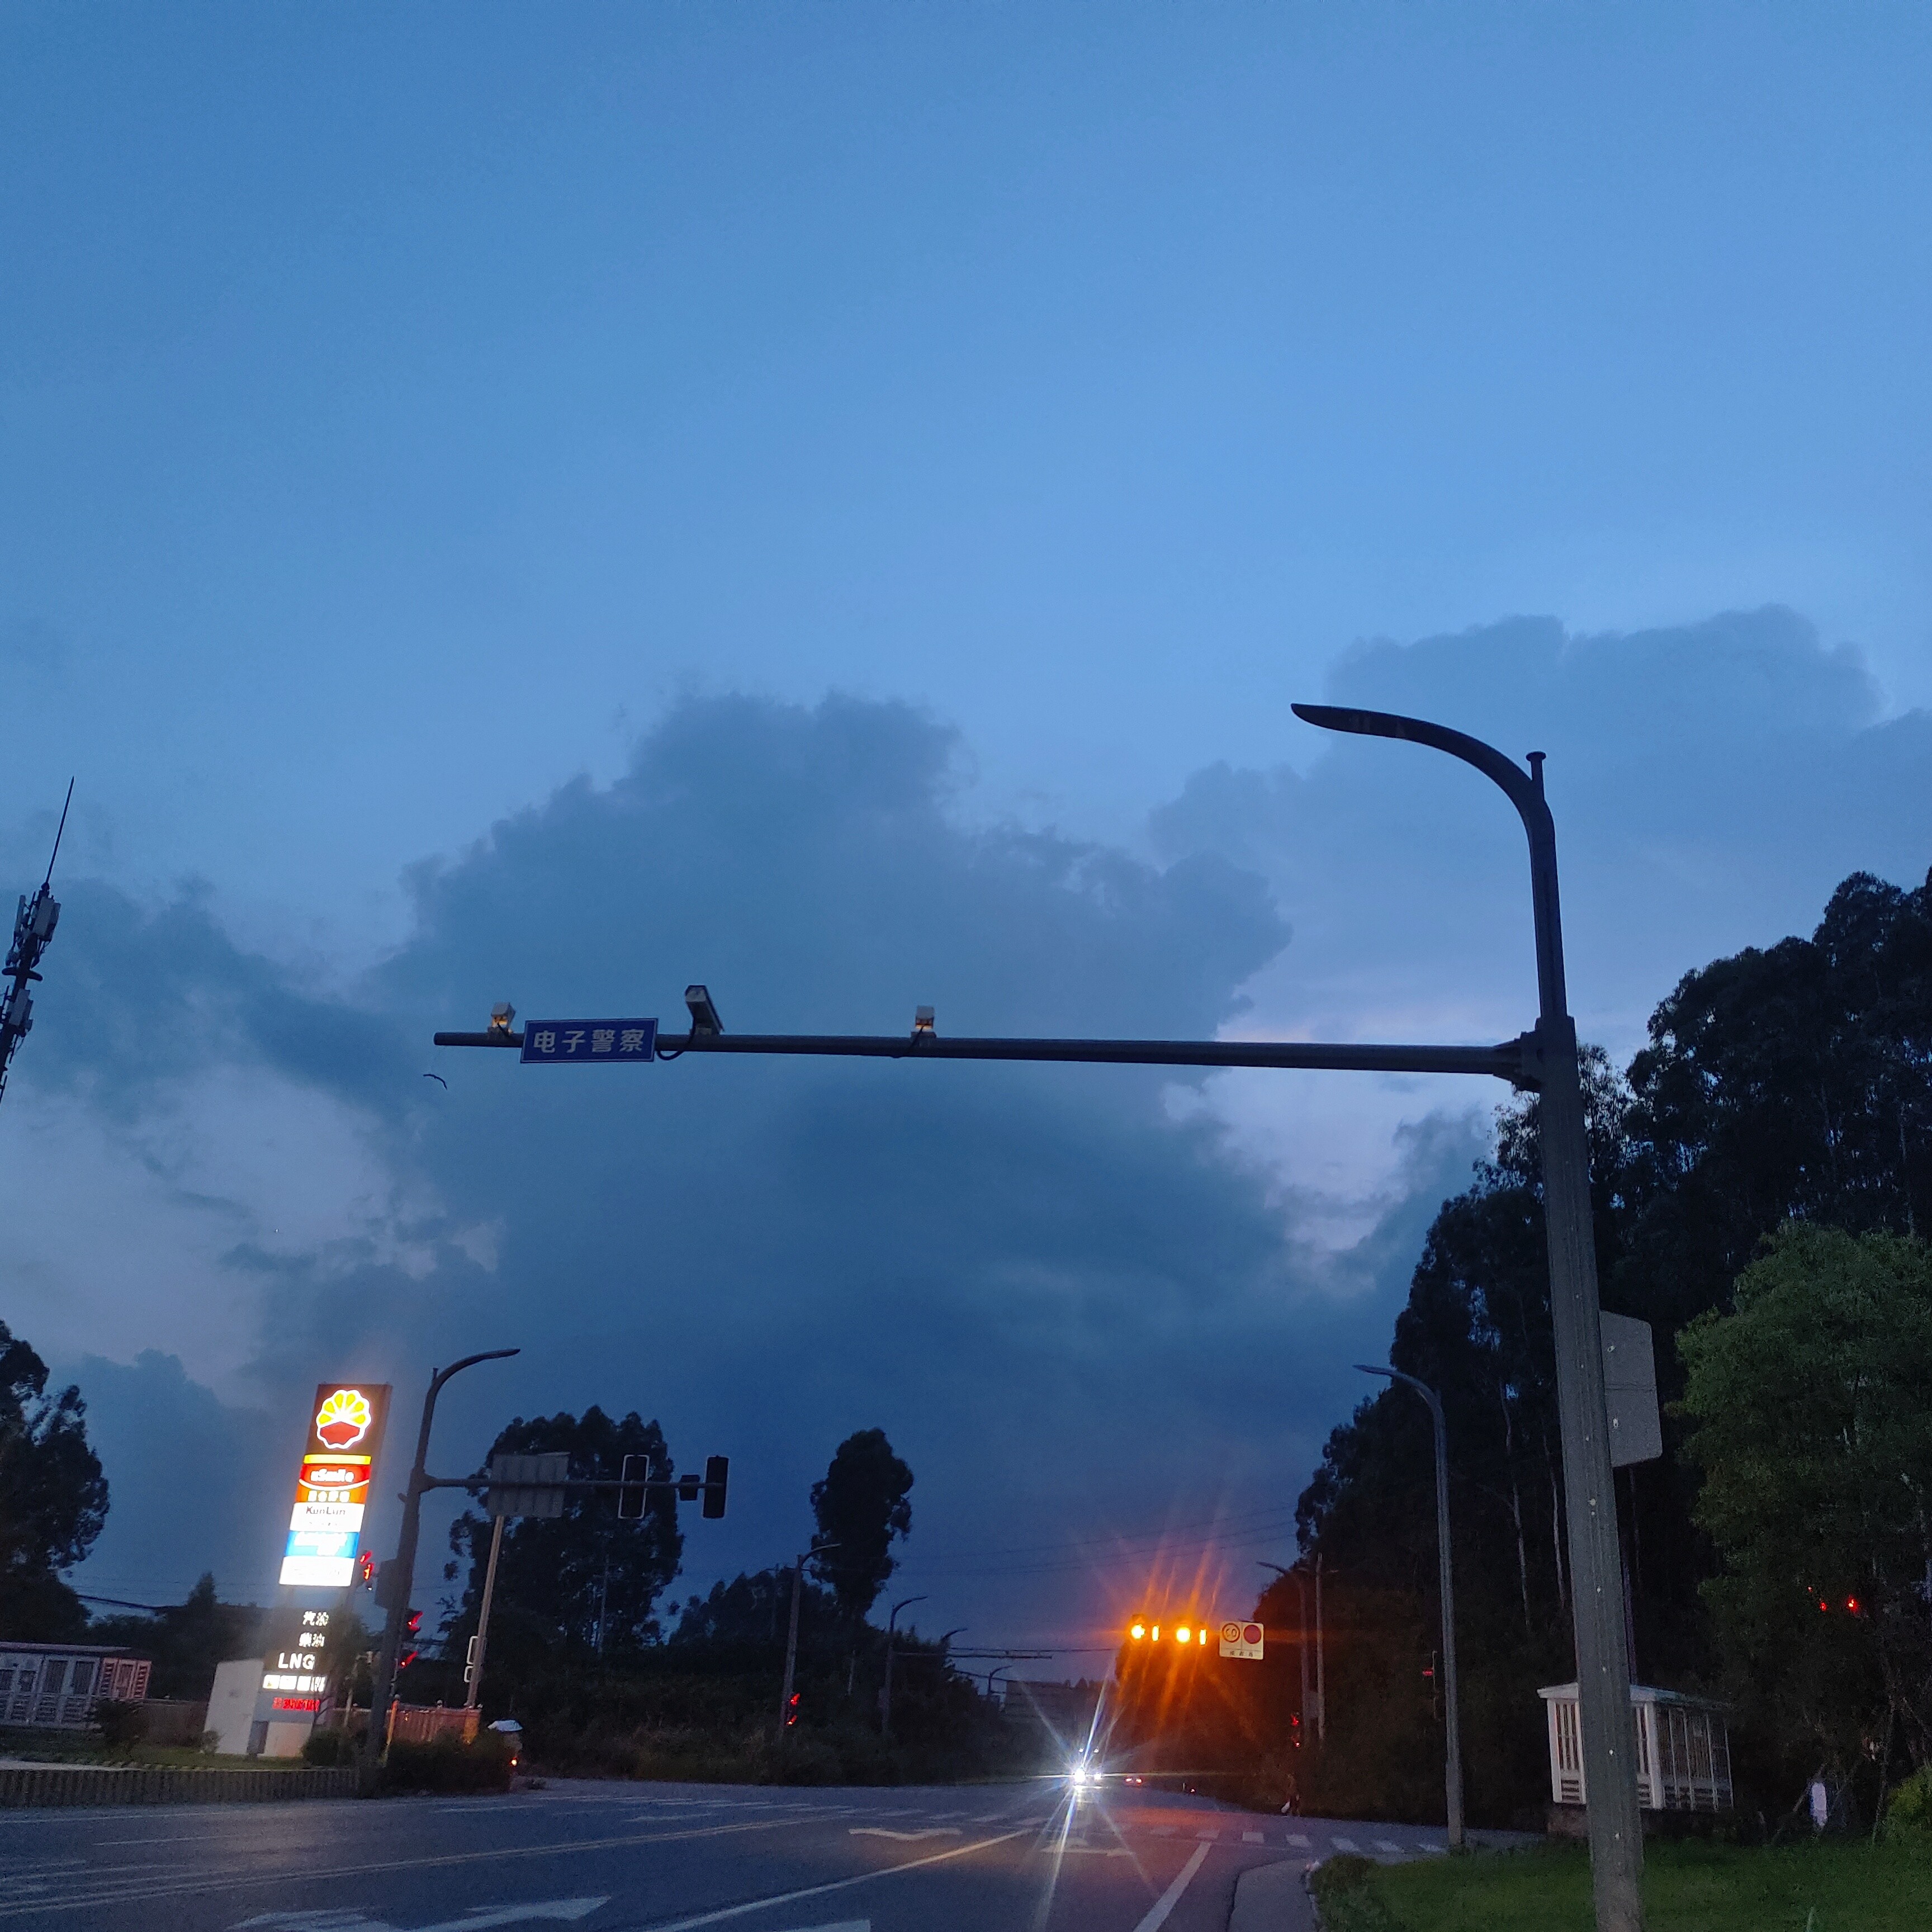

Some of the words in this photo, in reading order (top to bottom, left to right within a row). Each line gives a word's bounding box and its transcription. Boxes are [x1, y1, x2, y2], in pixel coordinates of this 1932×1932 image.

[533, 1029, 645, 1053] 电子警察
[306, 1506, 345, 1516] KunLun
[278, 1652, 315, 1670] LNG
